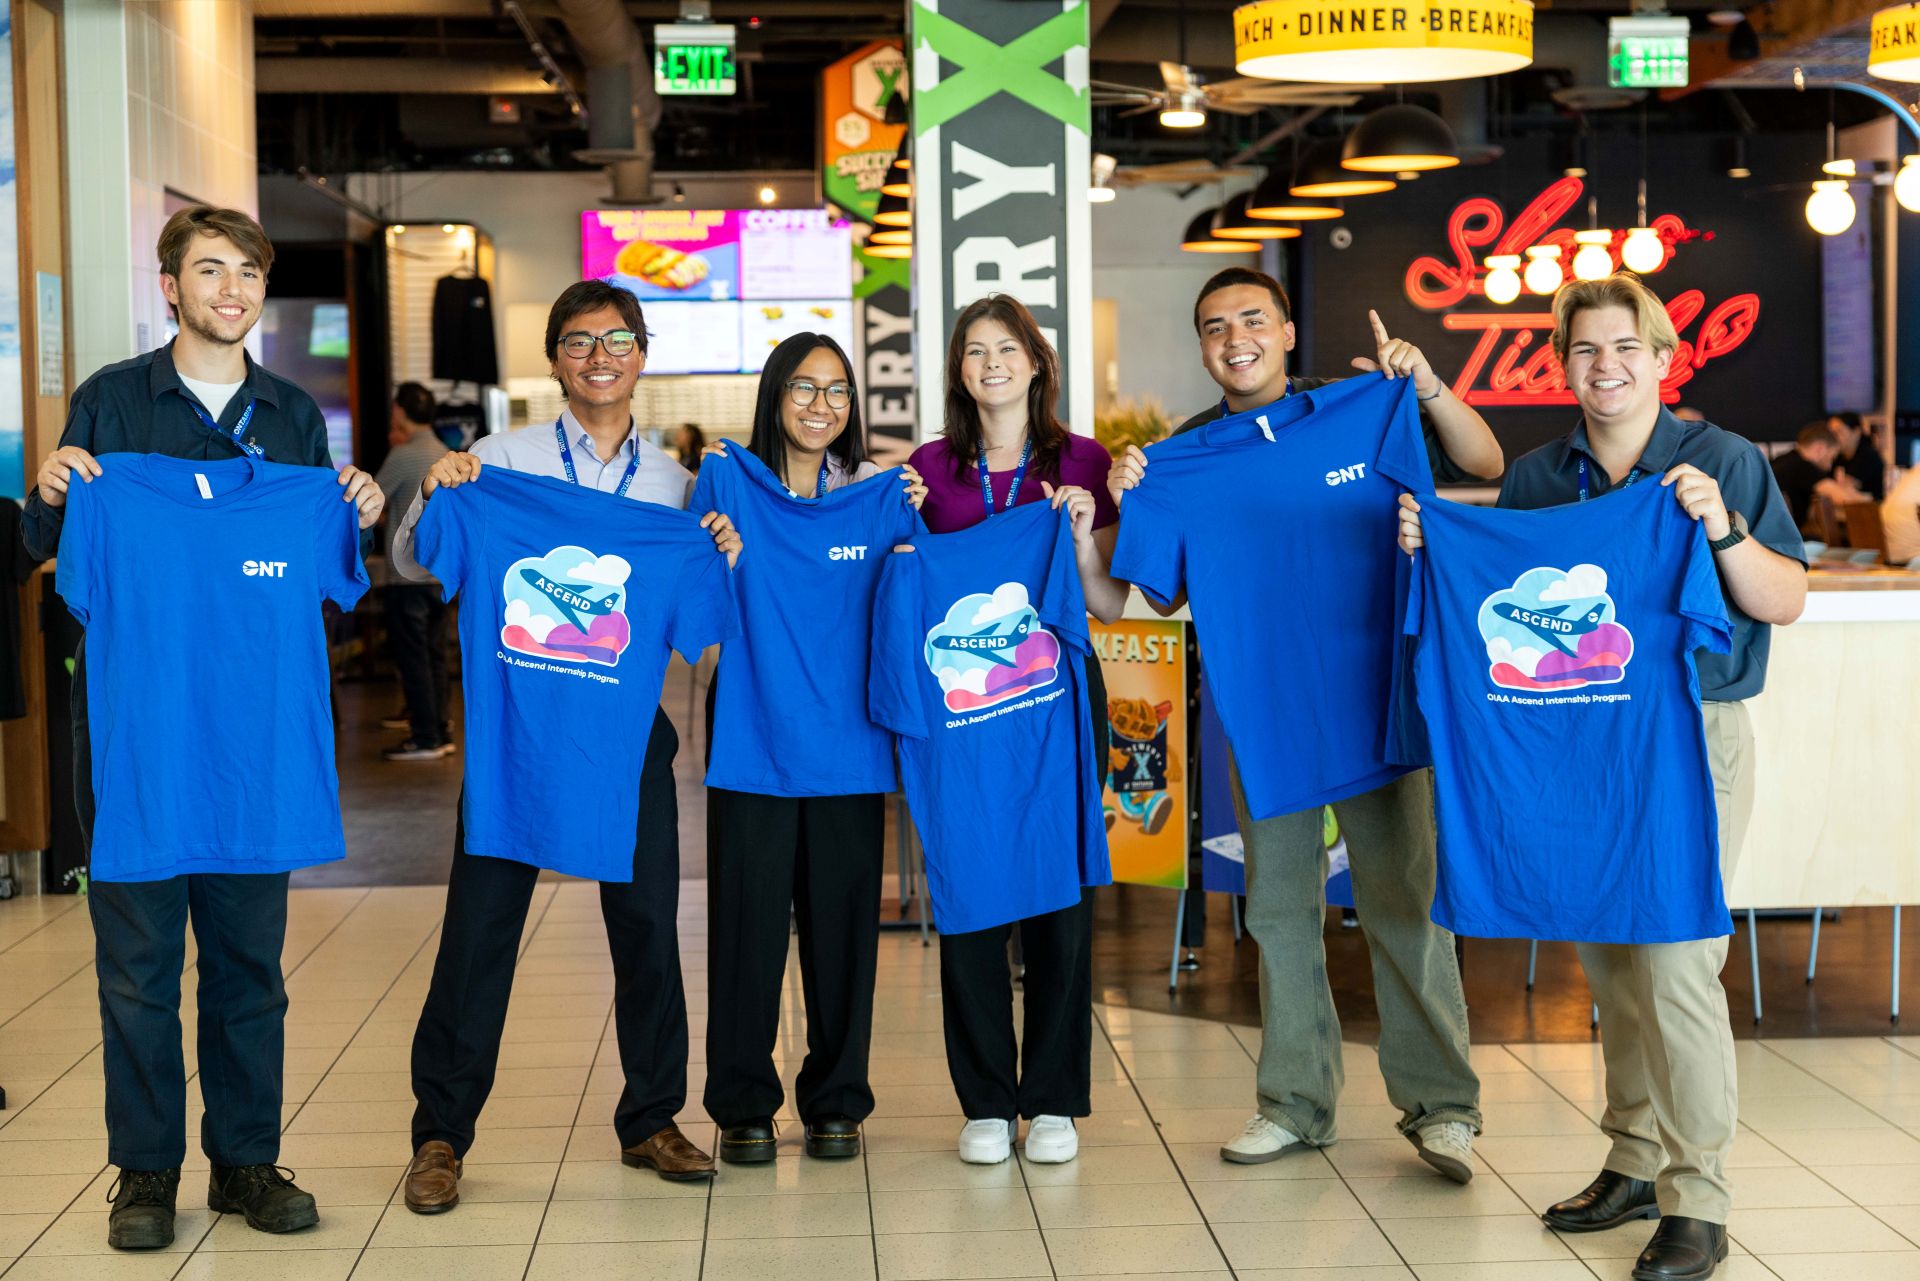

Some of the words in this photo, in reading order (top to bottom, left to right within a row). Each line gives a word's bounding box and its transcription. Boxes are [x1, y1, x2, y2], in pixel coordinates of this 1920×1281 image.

[1300, 8, 1407, 37] DINNER
[1429, 8, 1533, 41] BREAKFAS
[667, 46, 728, 90] EXIT
[1325, 462, 1366, 487] ONT
[828, 545, 868, 561] ONT
[242, 559, 288, 578] ONT
[535, 577, 591, 611] ASCEND
[1510, 608, 1573, 633] ASCEND
[949, 637, 1008, 649] ASCEND
[496, 651, 513, 665] OA
[514, 658, 546, 671] Ascend
[547, 663, 587, 679] Internship
[587, 671, 620, 685] Program
[945, 718, 968, 729] OIAA
[968, 710, 997, 724] Ascend
[997, 699, 1035, 716] Internship
[1034, 687, 1066, 705] Program
[1487, 693, 1510, 704] OIAA
[1511, 695, 1544, 706] Ascend
[1545, 694, 1591, 705] Internship
[1592, 692, 1631, 703] Program
